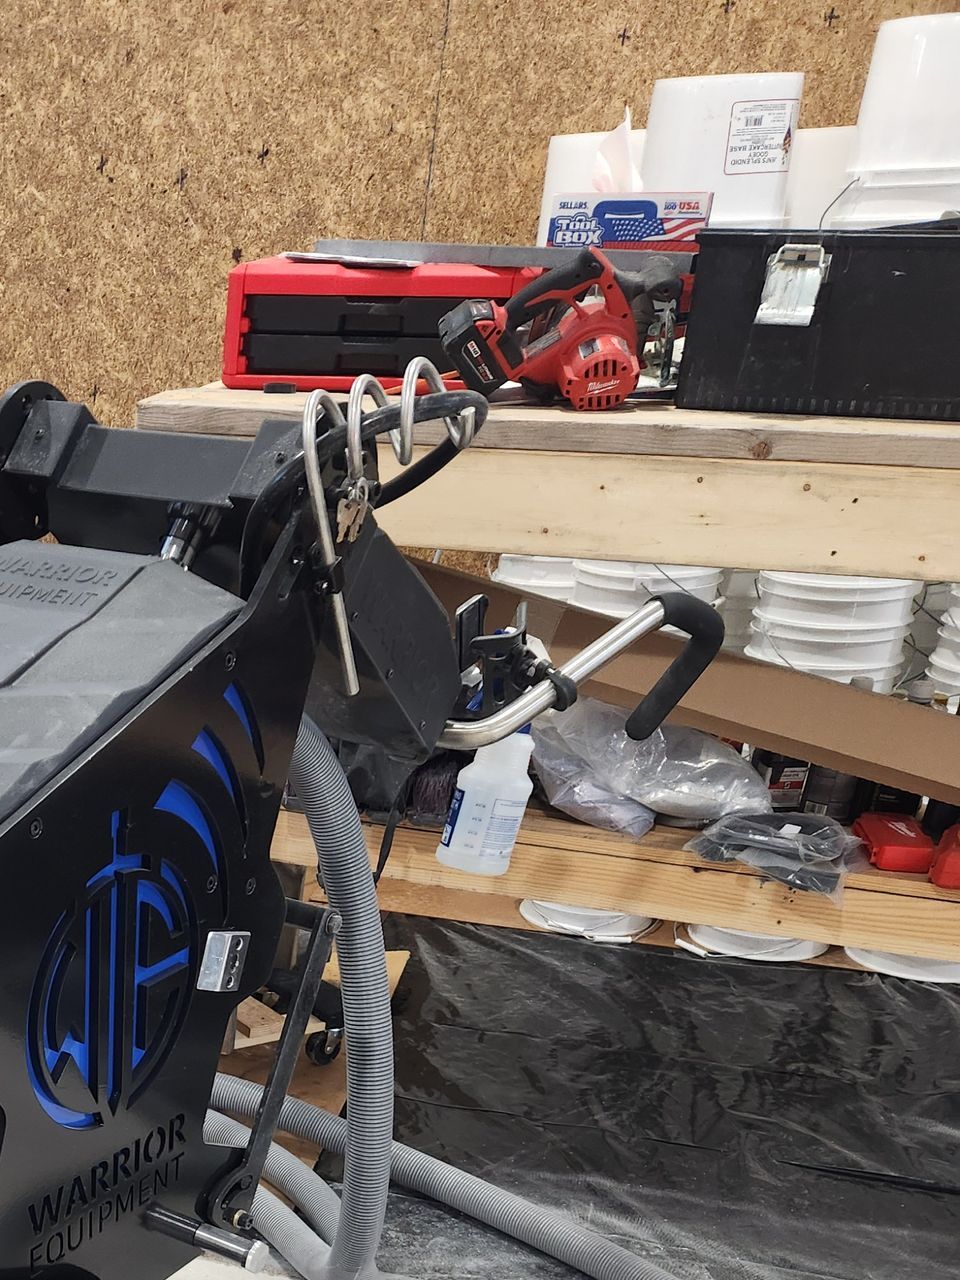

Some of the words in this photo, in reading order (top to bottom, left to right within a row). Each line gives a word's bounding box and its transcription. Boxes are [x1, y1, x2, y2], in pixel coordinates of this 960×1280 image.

[559, 201, 587, 210] SELLARS
[679, 201, 700, 210] USA
[557, 219, 599, 230] TOOL
[555, 229, 603, 245] BOX
[28, 1112, 187, 1236] WARRIOR
[29, 1151, 186, 1278] EQUIPMENT
